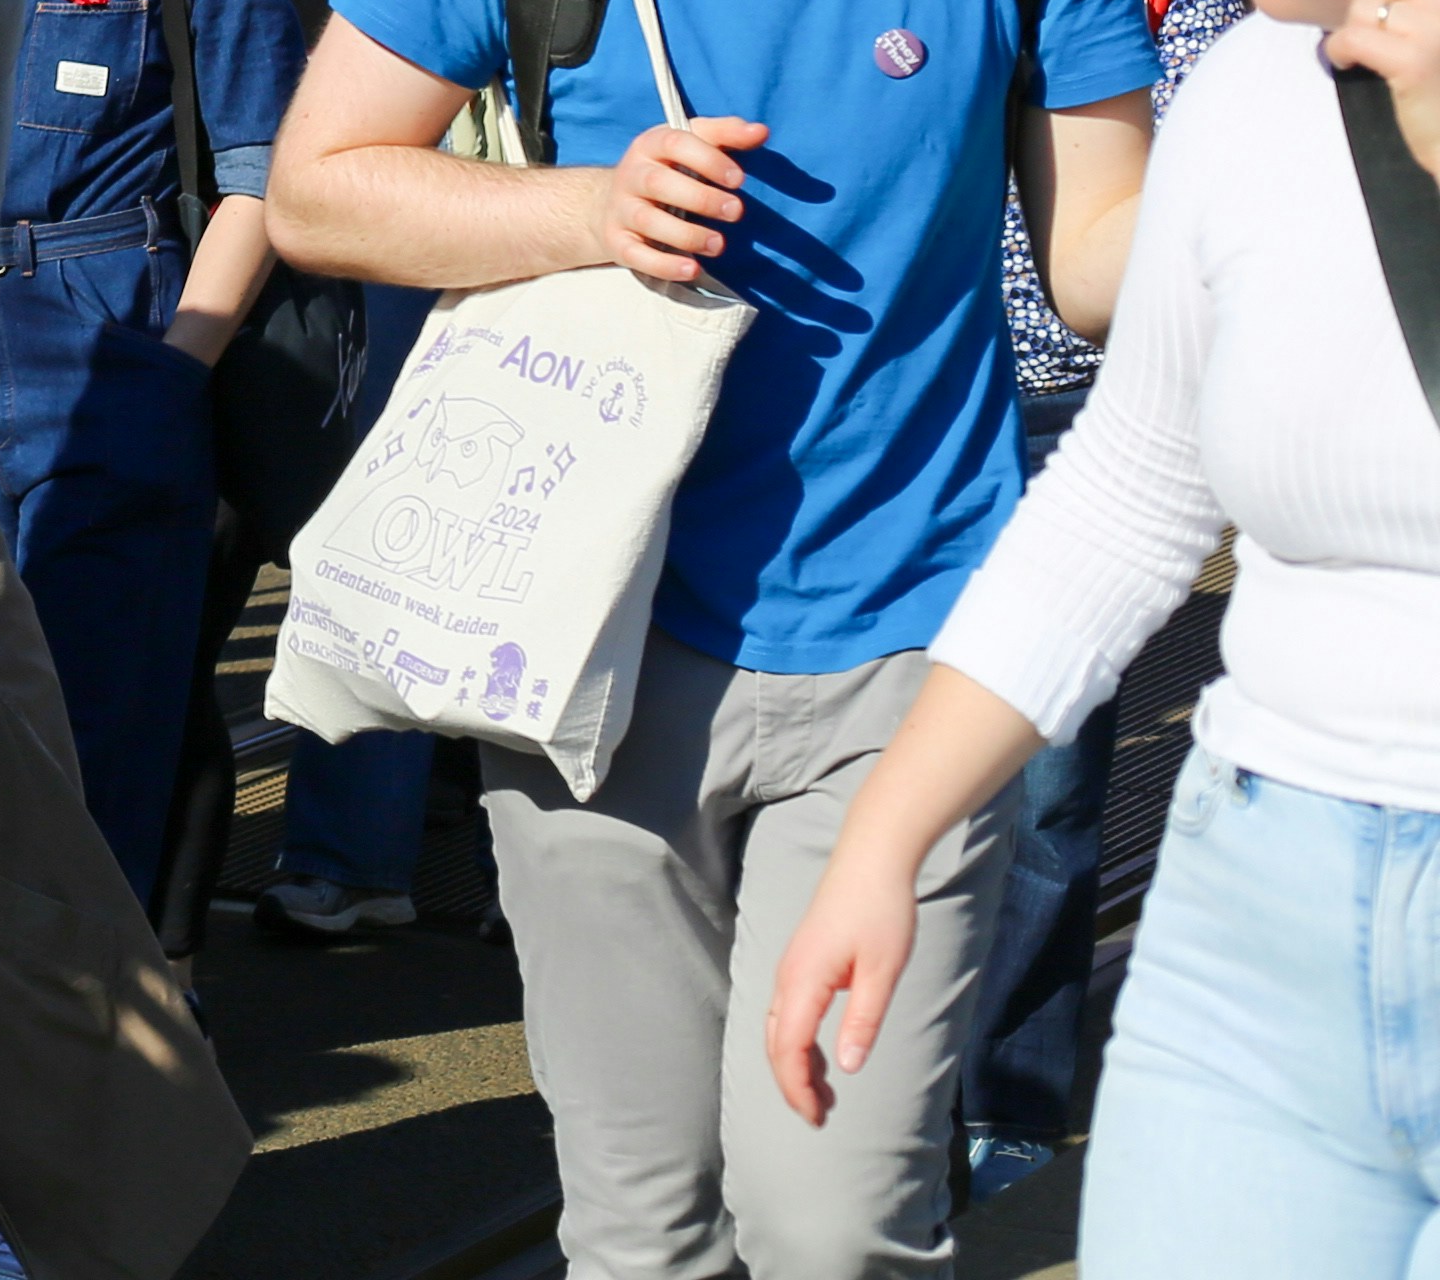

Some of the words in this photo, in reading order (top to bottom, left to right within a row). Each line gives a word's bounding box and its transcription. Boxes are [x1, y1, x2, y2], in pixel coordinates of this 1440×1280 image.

[372, 494, 533, 605] OWL
[489, 502, 542, 534] 2024
[314, 557, 402, 608] Orientation
[403, 591, 445, 624] week
[444, 609, 501, 638] Leiden
